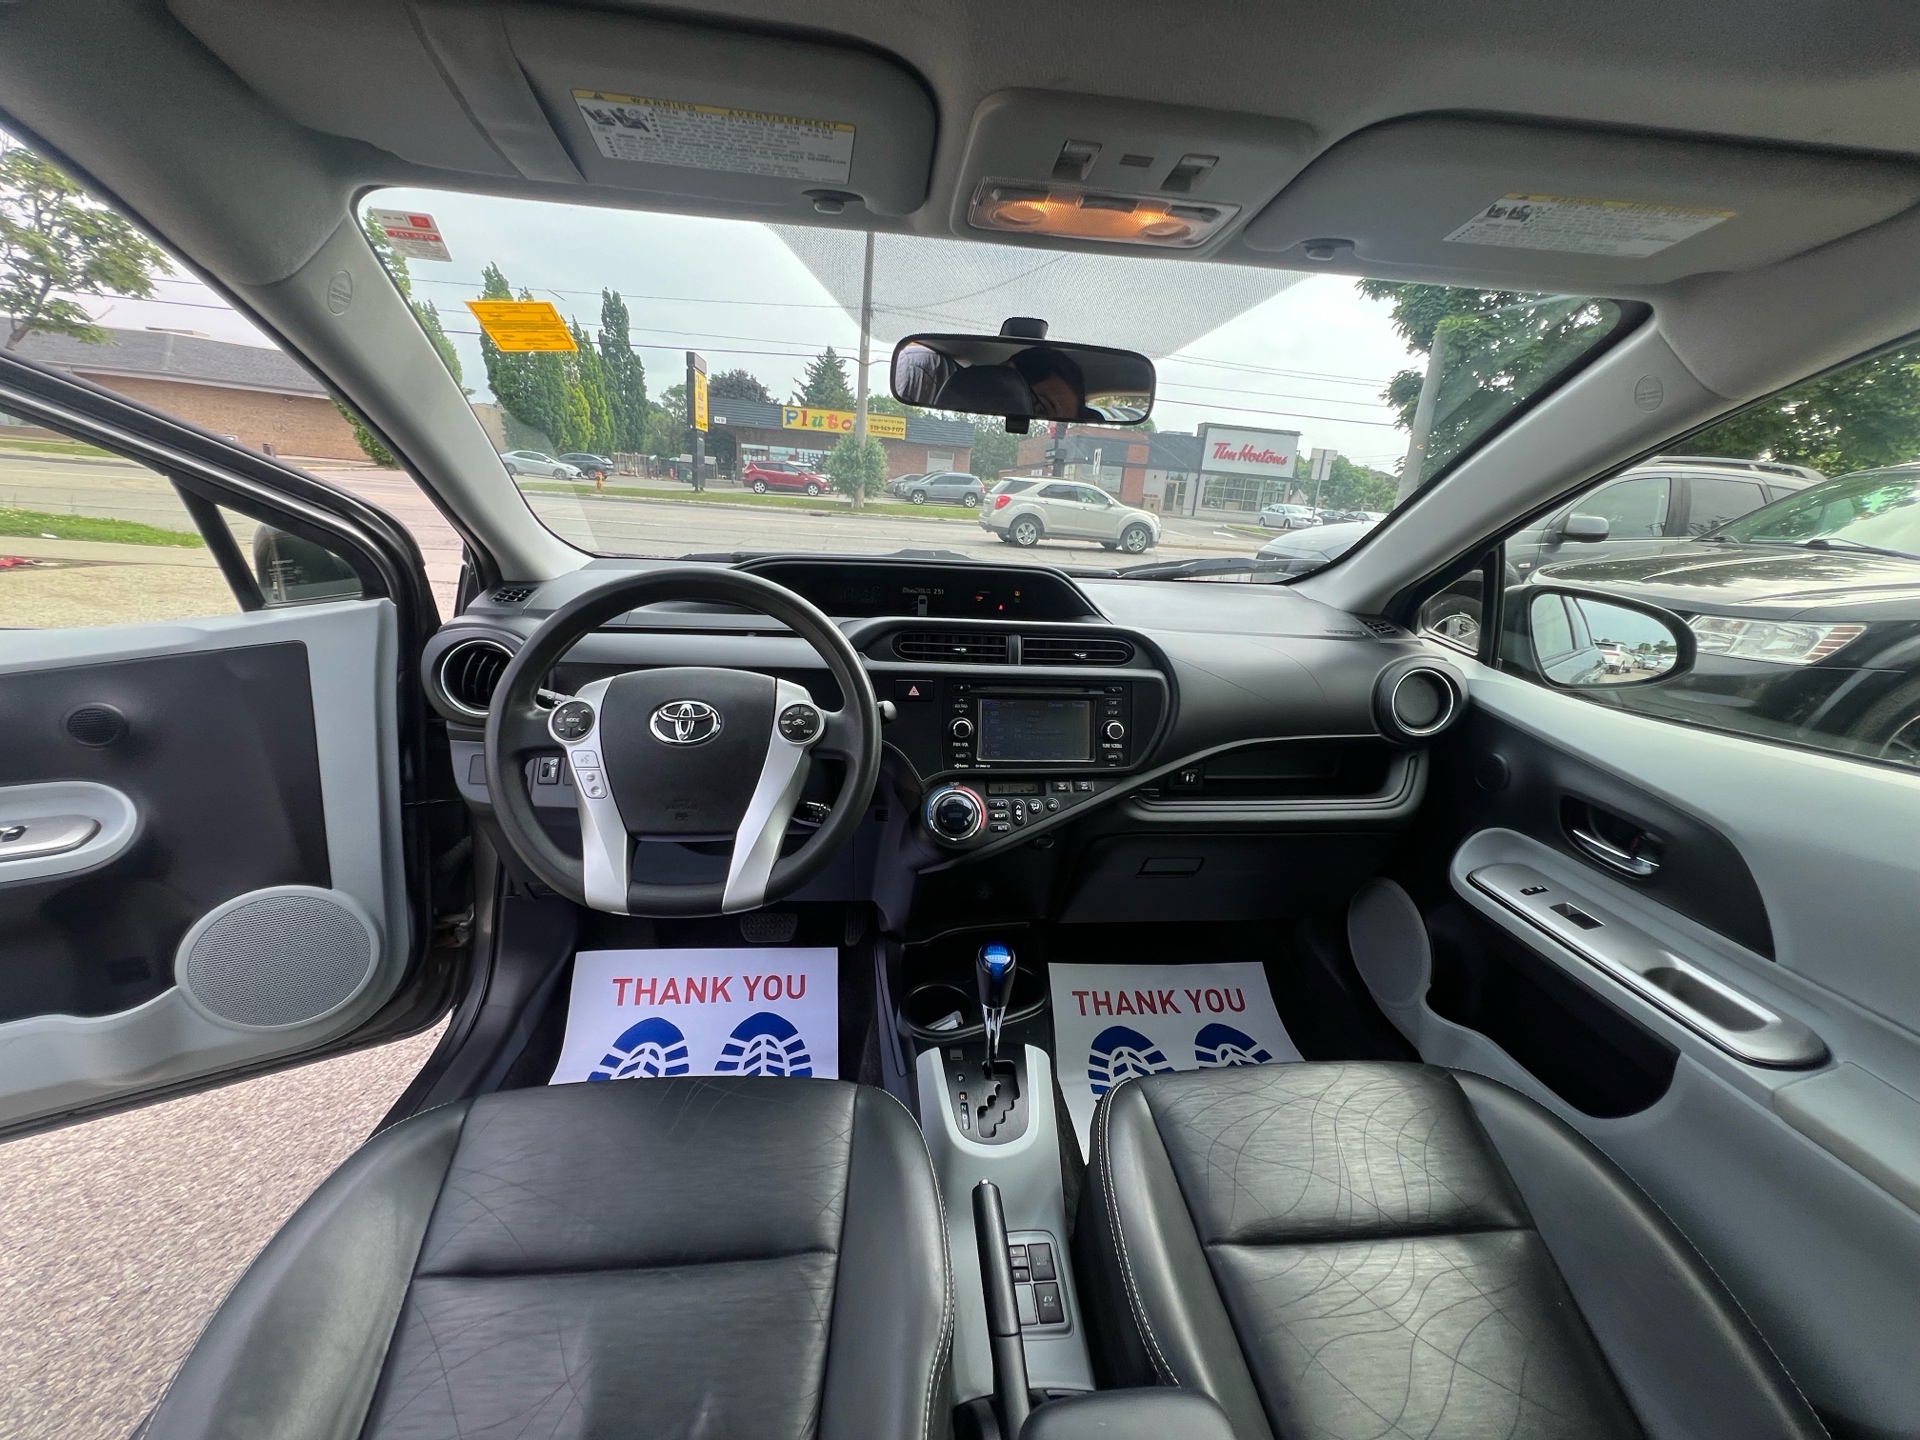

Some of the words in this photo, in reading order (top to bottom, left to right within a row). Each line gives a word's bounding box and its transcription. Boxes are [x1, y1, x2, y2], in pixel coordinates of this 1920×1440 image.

[630, 97, 697, 112] WARNING
[728, 109, 839, 130] AVERTISSEMENT
[1212, 442, 1237, 460] Tim
[1237, 443, 1289, 465] Hortons
[612, 975, 733, 1007] THANK
[743, 974, 807, 1002] YOU
[1072, 989, 1182, 1016] THANK
[1184, 988, 1246, 1013] YOU
